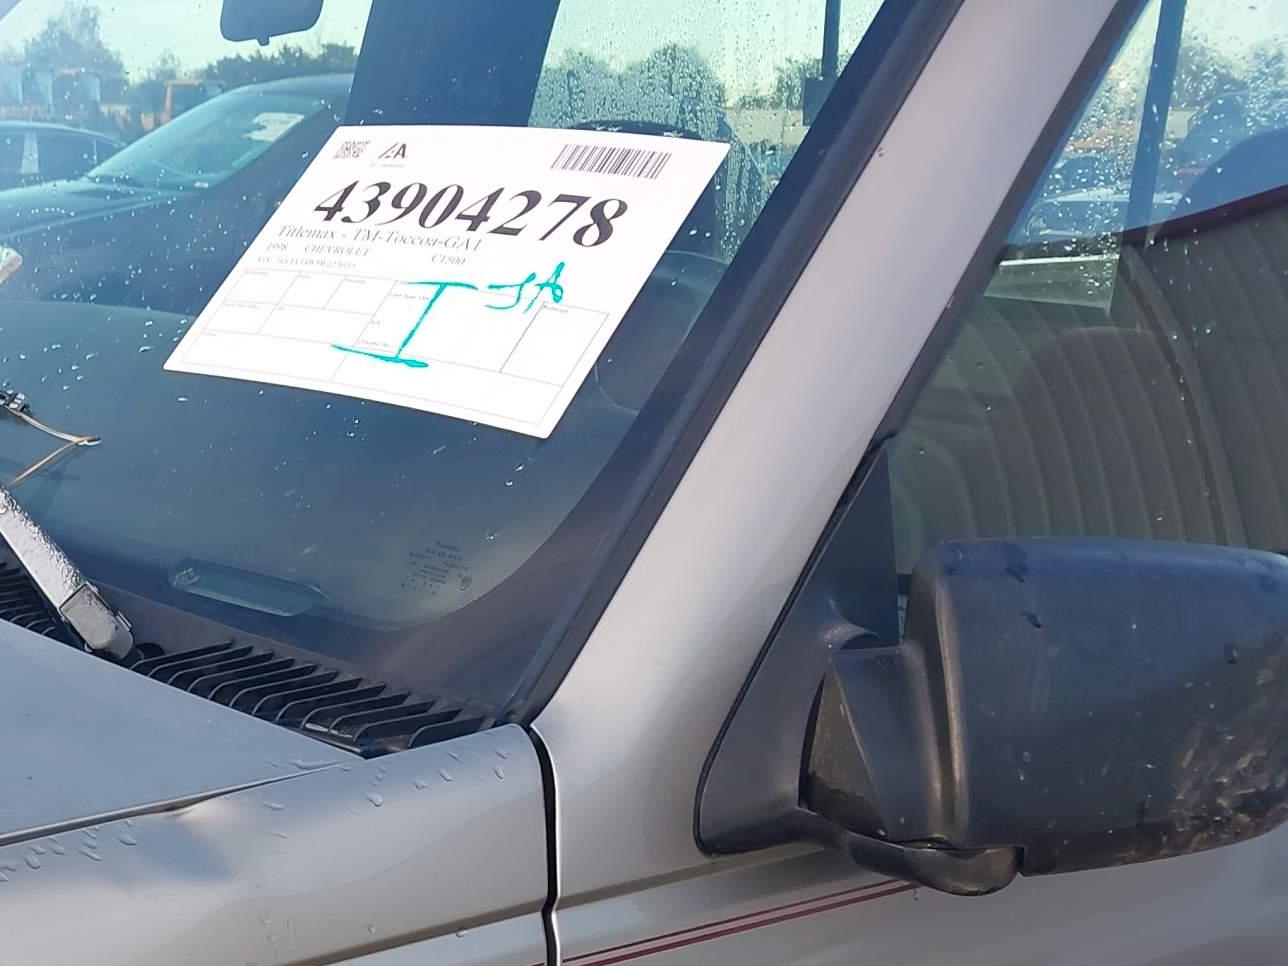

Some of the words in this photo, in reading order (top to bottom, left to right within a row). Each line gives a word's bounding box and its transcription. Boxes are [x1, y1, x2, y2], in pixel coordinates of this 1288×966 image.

[313, 180, 628, 248] 43904278
[277, 224, 336, 240] Titlemax
[304, 243, 372, 257] CHEVROLET
[430, 253, 467, 265] C1500
